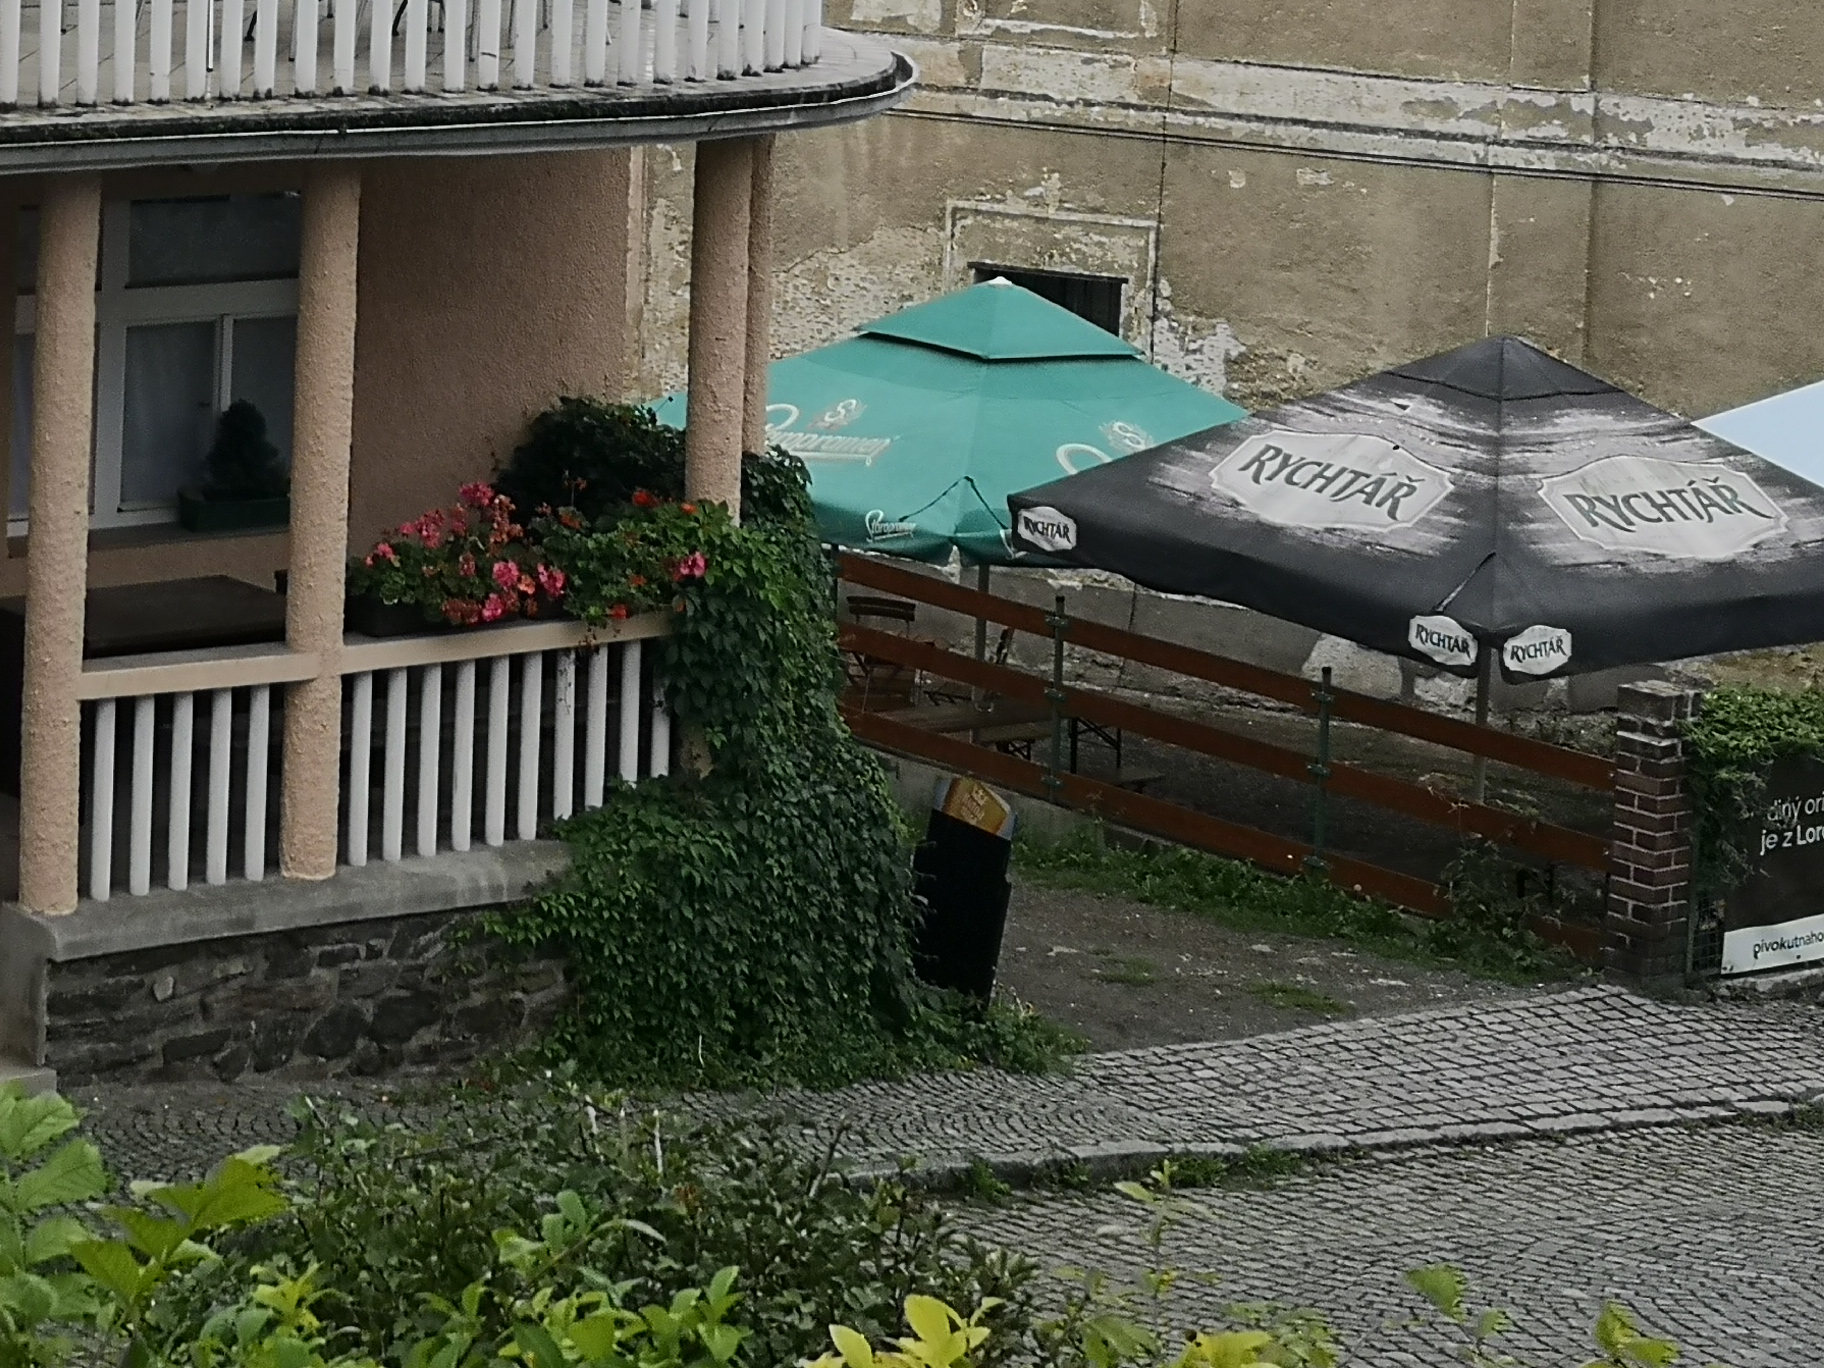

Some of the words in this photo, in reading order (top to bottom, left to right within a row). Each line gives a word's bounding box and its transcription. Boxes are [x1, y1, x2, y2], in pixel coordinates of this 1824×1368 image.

[1239, 444, 1426, 520] RYCHTÁŘ
[1561, 476, 1774, 533] RYCHTÁŘ
[1415, 623, 1471, 660] RYCHTÁŘ
[1509, 637, 1565, 661] RYCHTÁŘ
[1759, 829, 1779, 856] je
[1782, 831, 1793, 847] z
